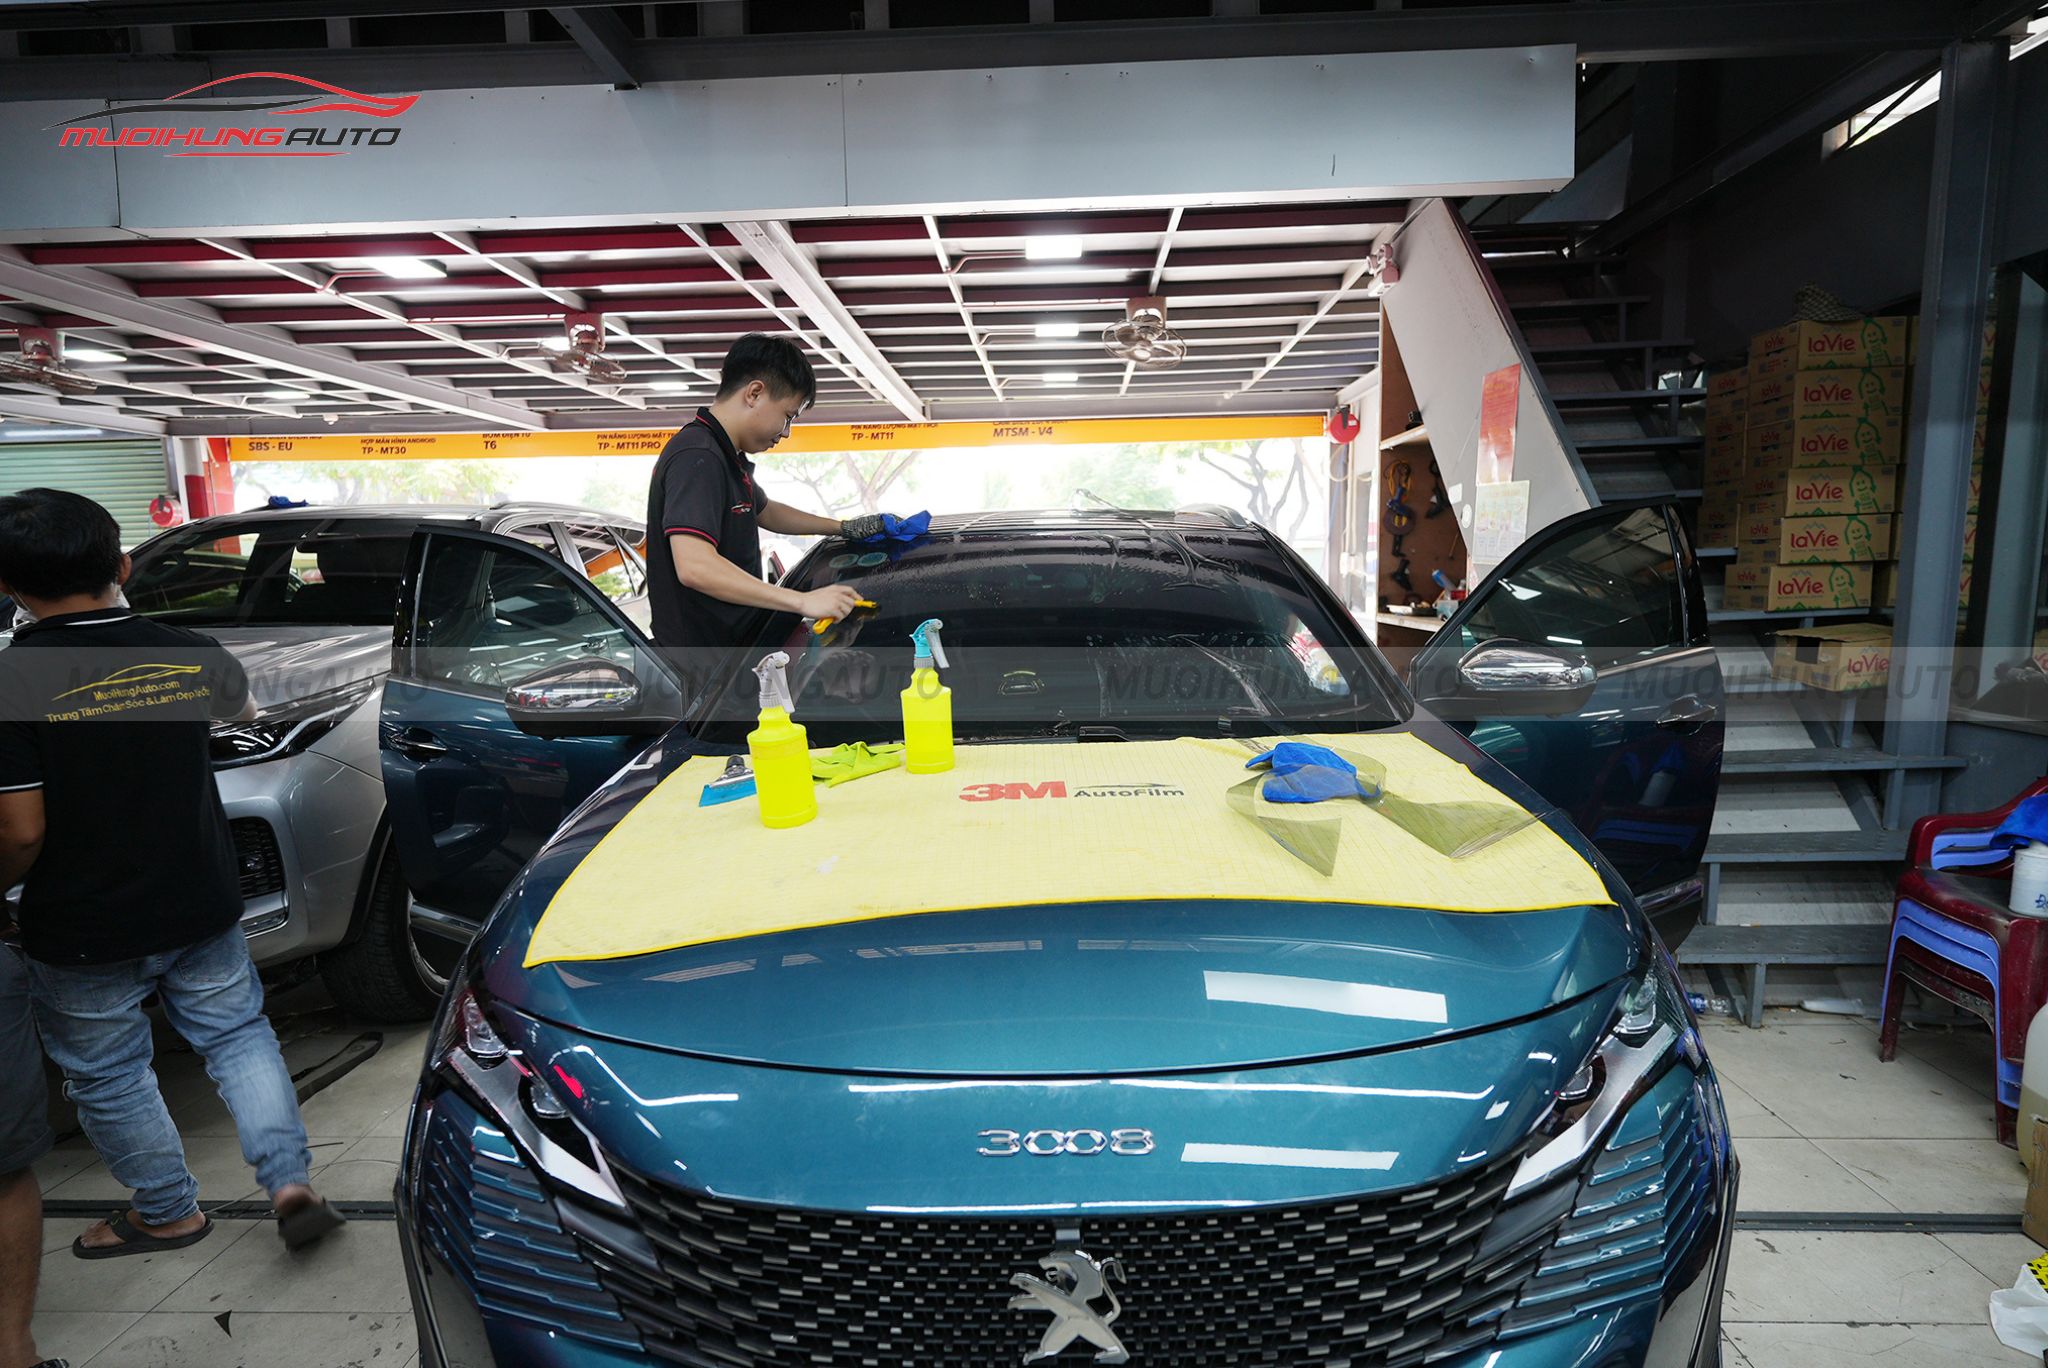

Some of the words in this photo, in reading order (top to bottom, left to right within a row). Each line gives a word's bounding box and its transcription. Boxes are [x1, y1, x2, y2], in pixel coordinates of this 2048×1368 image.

[1808, 333, 1856, 354] laVie
[1804, 383, 1853, 403] laVie
[851, 432, 864, 440] TP
[870, 431, 894, 440] MT11
[993, 427, 1029, 437] MTSM
[1038, 426, 1053, 436] V4
[248, 441, 270, 451] SBS
[278, 441, 293, 451] EU
[362, 446, 374, 454] TP
[380, 446, 407, 455] MT30
[484, 440, 497, 450] T6
[598, 442, 610, 450] TP
[616, 441, 639, 450] MT11
[641, 441, 661, 449] PRO
[1801, 433, 1849, 453] laVie
[1796, 482, 1844, 502] laVie
[1790, 530, 1839, 549] laVie
[1777, 577, 1824, 596] laVie
[1847, 654, 1889, 674] laVie
[46, 711, 80, 723] Trung
[145, 697, 155, 706] &
[958, 780, 1068, 802] 3M
[1073, 788, 1185, 798] AutoFilm
[976, 1127, 1157, 1157] 3008
